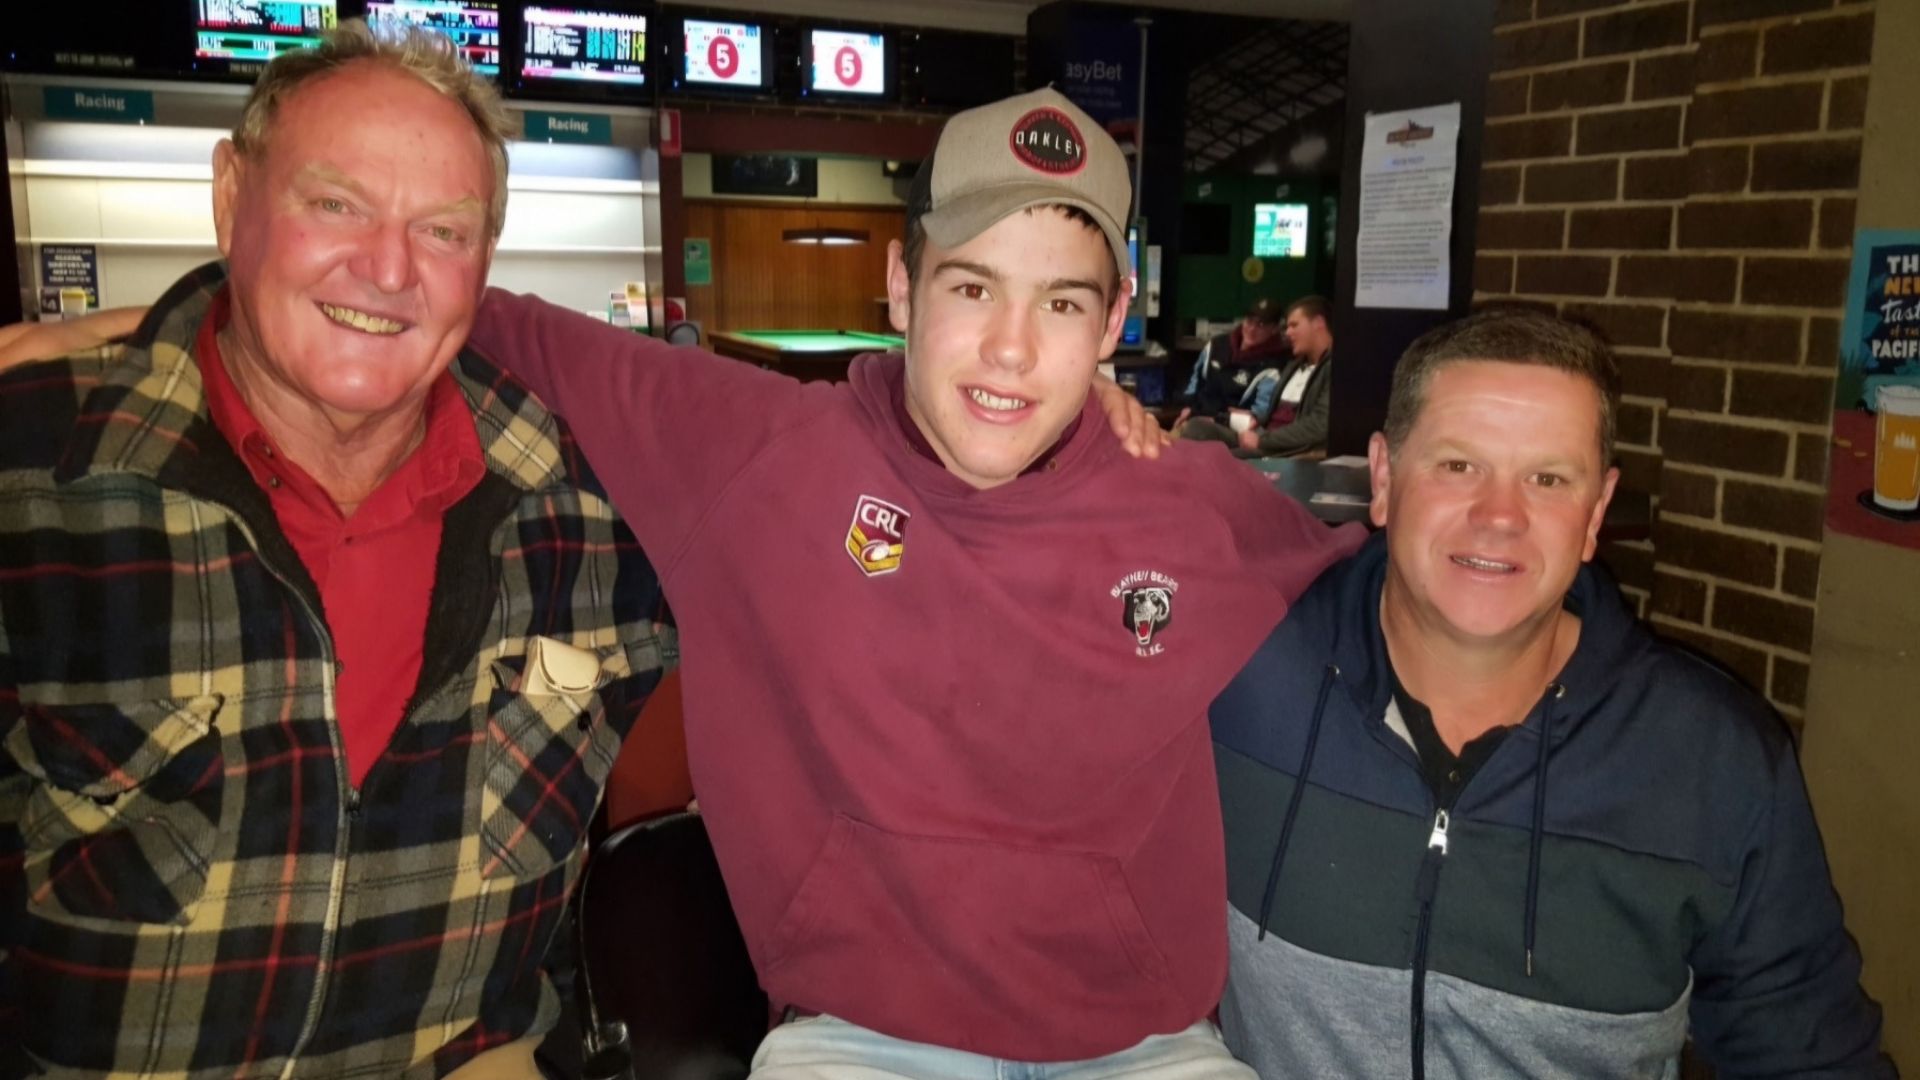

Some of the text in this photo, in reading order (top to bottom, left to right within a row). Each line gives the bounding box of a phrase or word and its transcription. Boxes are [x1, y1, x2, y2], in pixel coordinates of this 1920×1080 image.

[716, 43, 732, 70] 5
[841, 51, 856, 79] 5
[75, 92, 126, 111] Racing
[549, 117, 588, 133] Racing
[1015, 131, 1082, 159] OAKLEY
[1871, 338, 1920, 359] PACIF
[860, 503, 901, 538] CRL
[1150, 570, 1179, 593] BEARS
